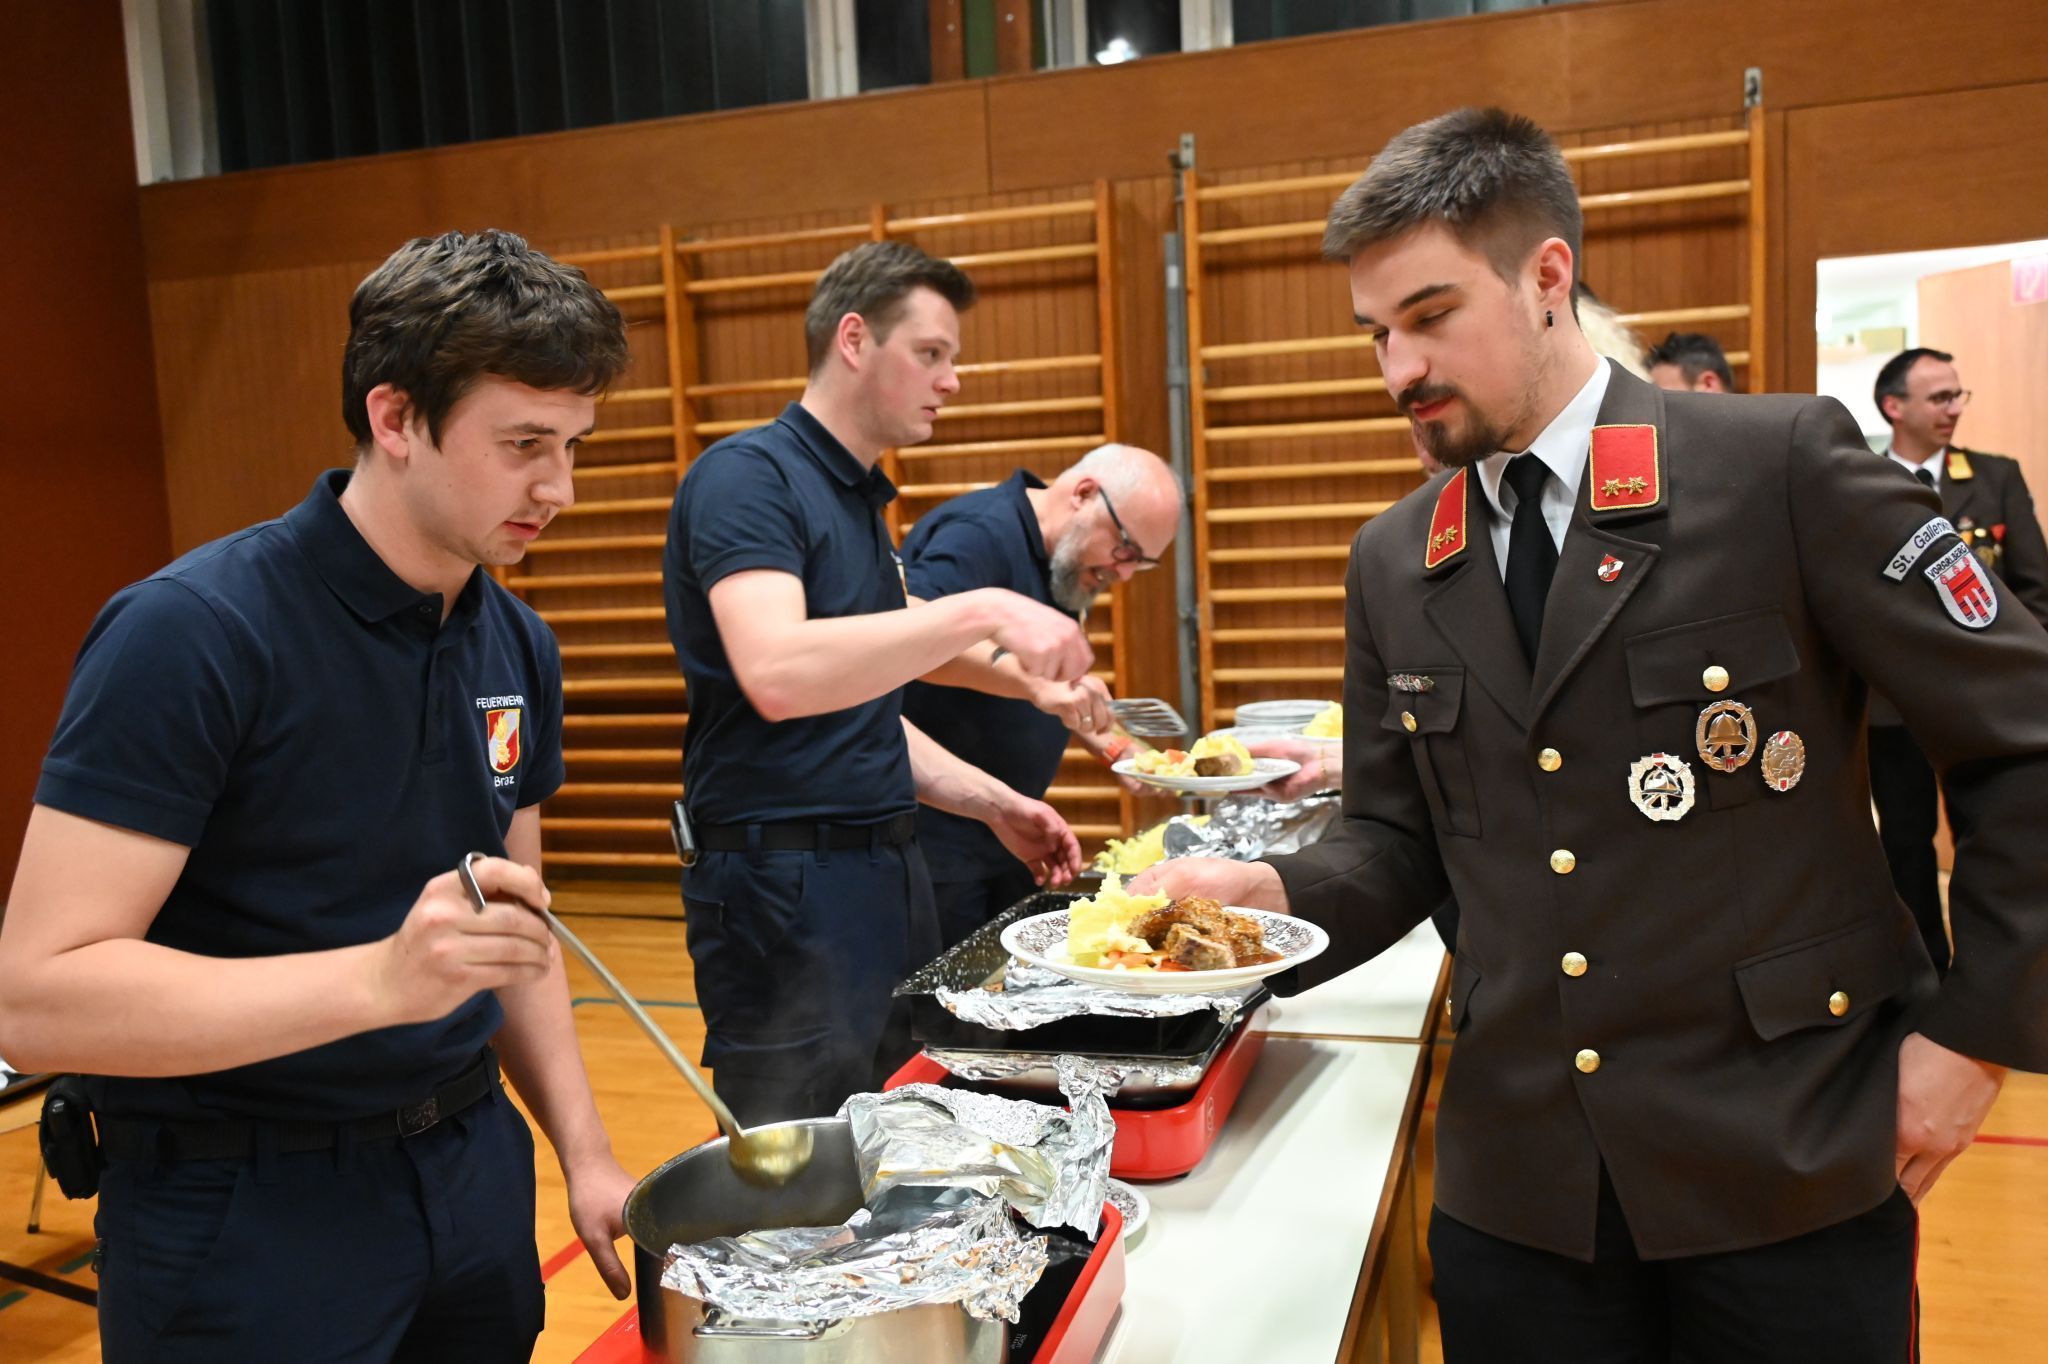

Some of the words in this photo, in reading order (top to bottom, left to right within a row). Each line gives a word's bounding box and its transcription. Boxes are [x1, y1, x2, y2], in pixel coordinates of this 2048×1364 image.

[1892, 554, 1915, 573] St.
[475, 695, 525, 709] FEUERWEHR
[494, 775, 515, 787] Braz
